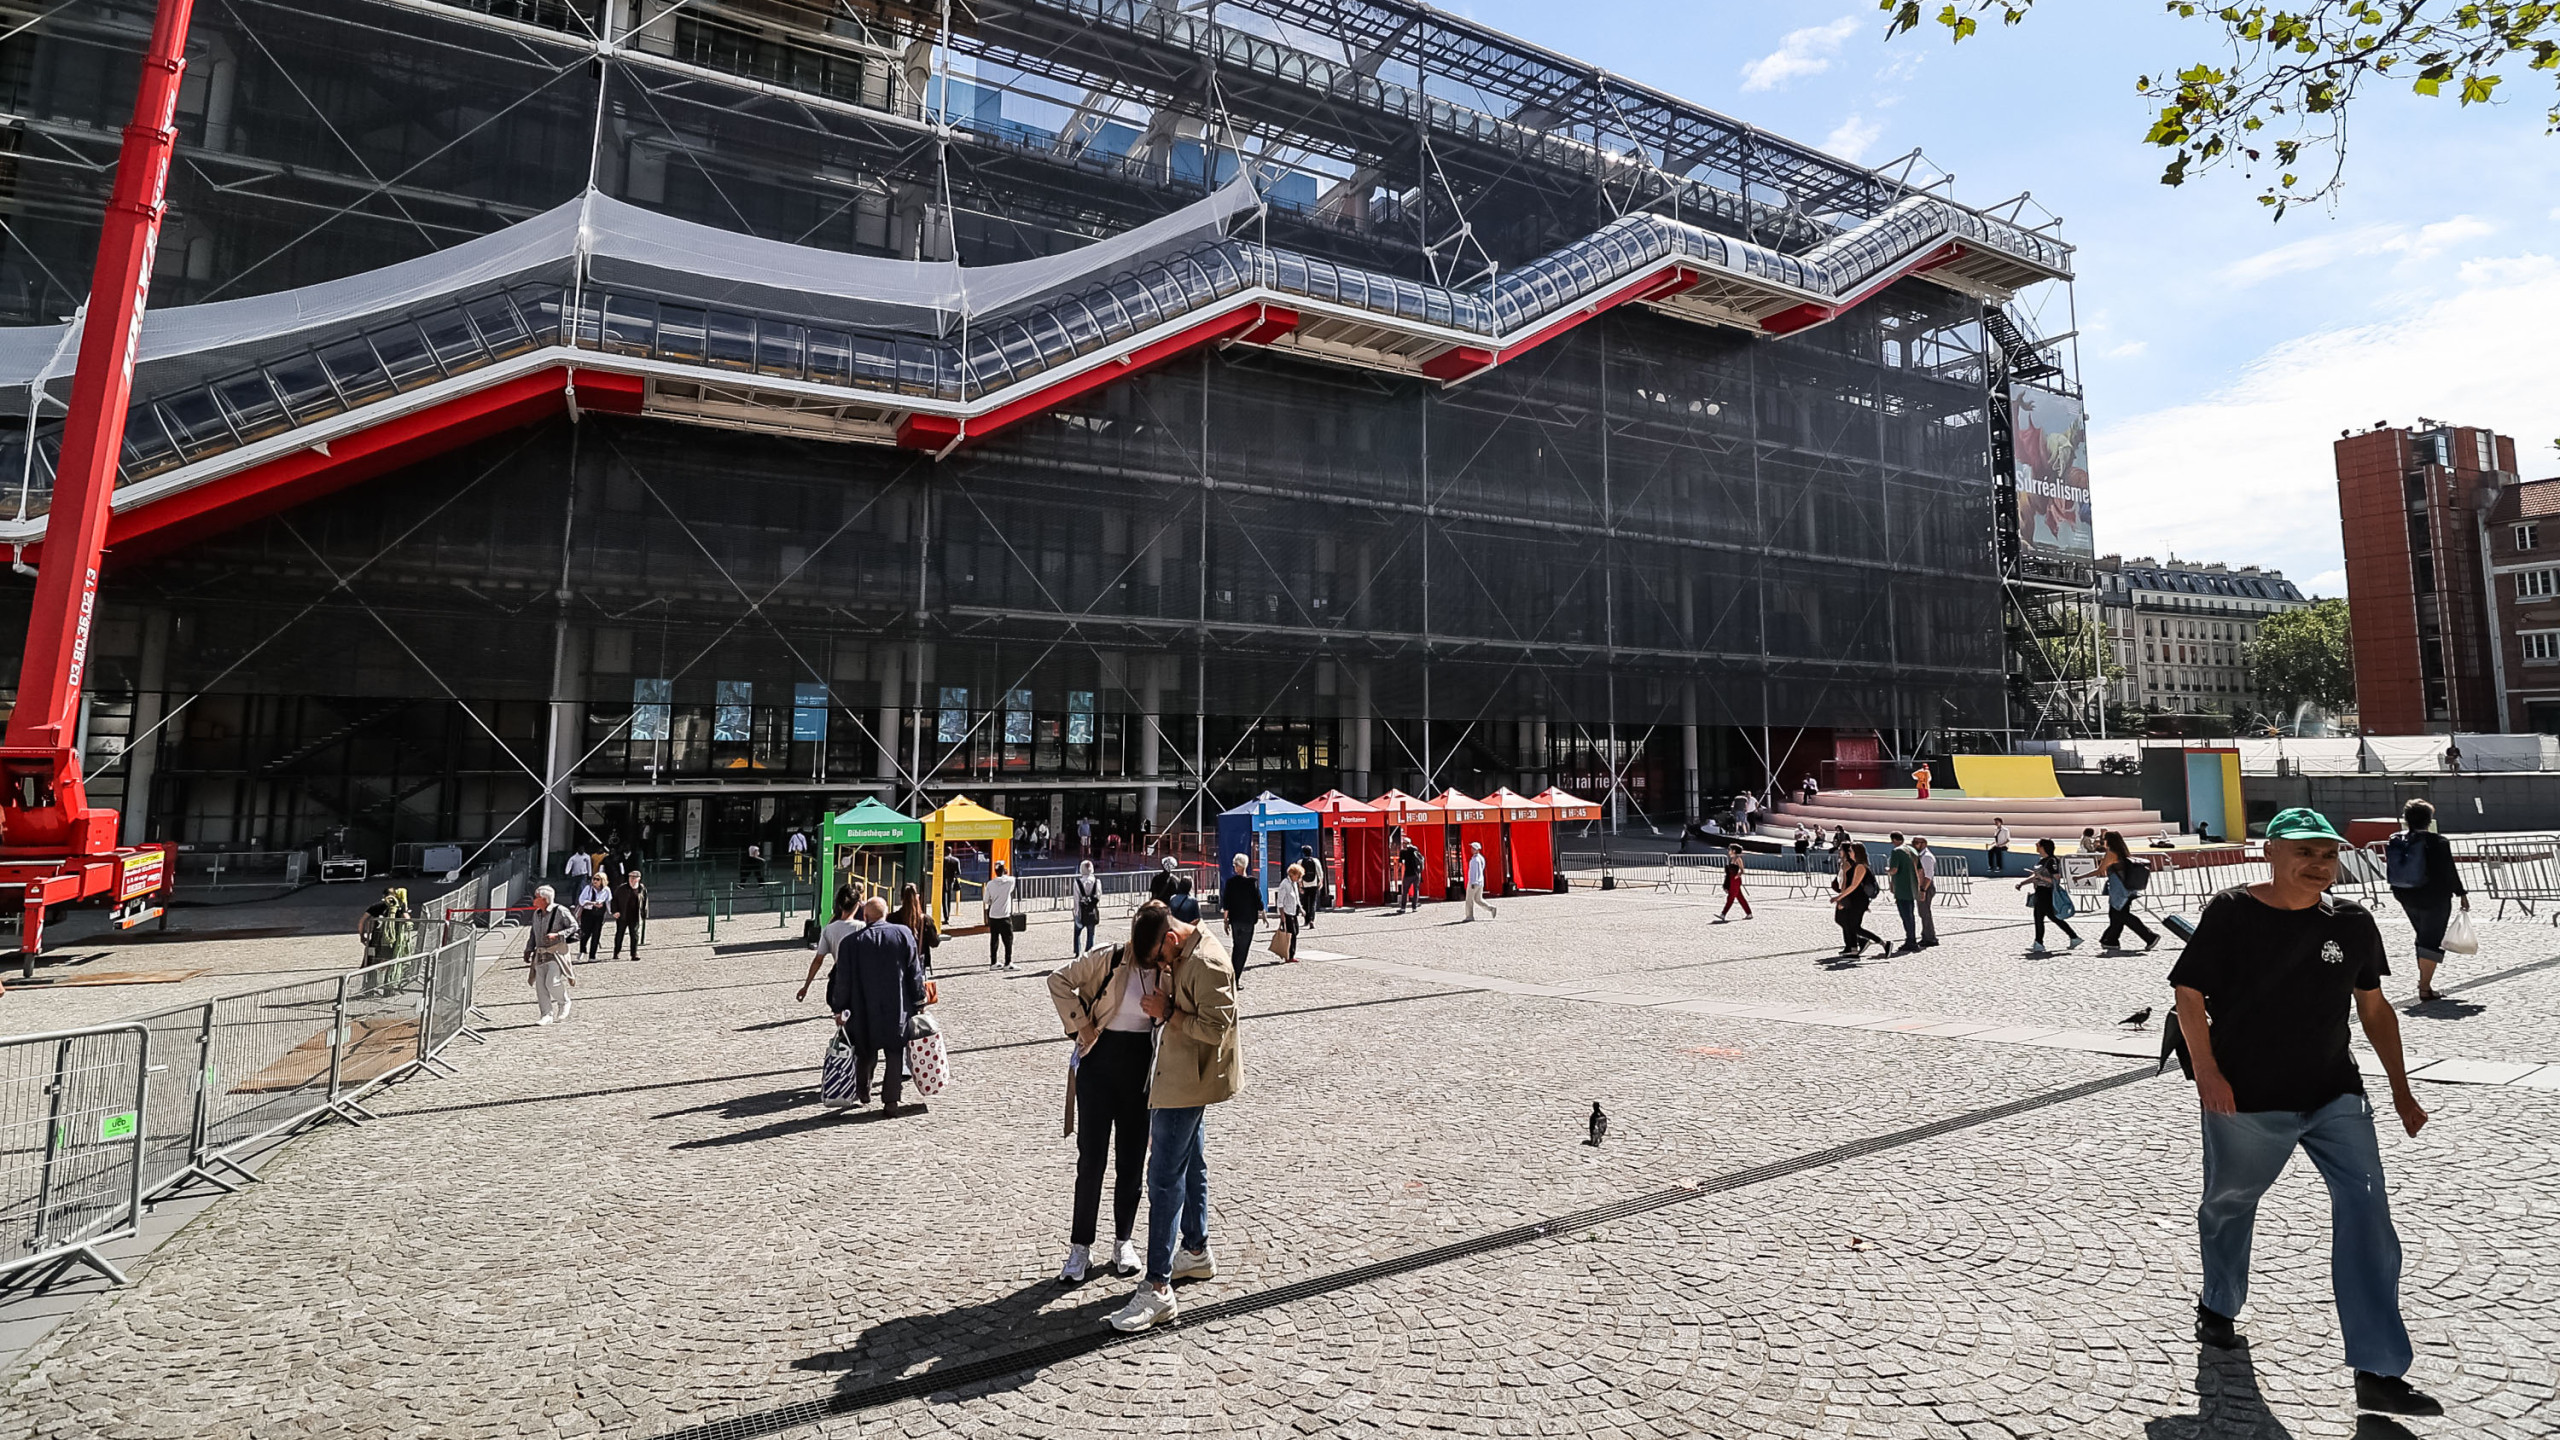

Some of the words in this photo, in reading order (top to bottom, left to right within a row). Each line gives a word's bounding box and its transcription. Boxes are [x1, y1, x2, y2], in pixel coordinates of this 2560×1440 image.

[2015, 470, 2090, 504] Surréalisme
[847, 828, 890, 838] Bibliothèque
[891, 828, 904, 838] Bpi
